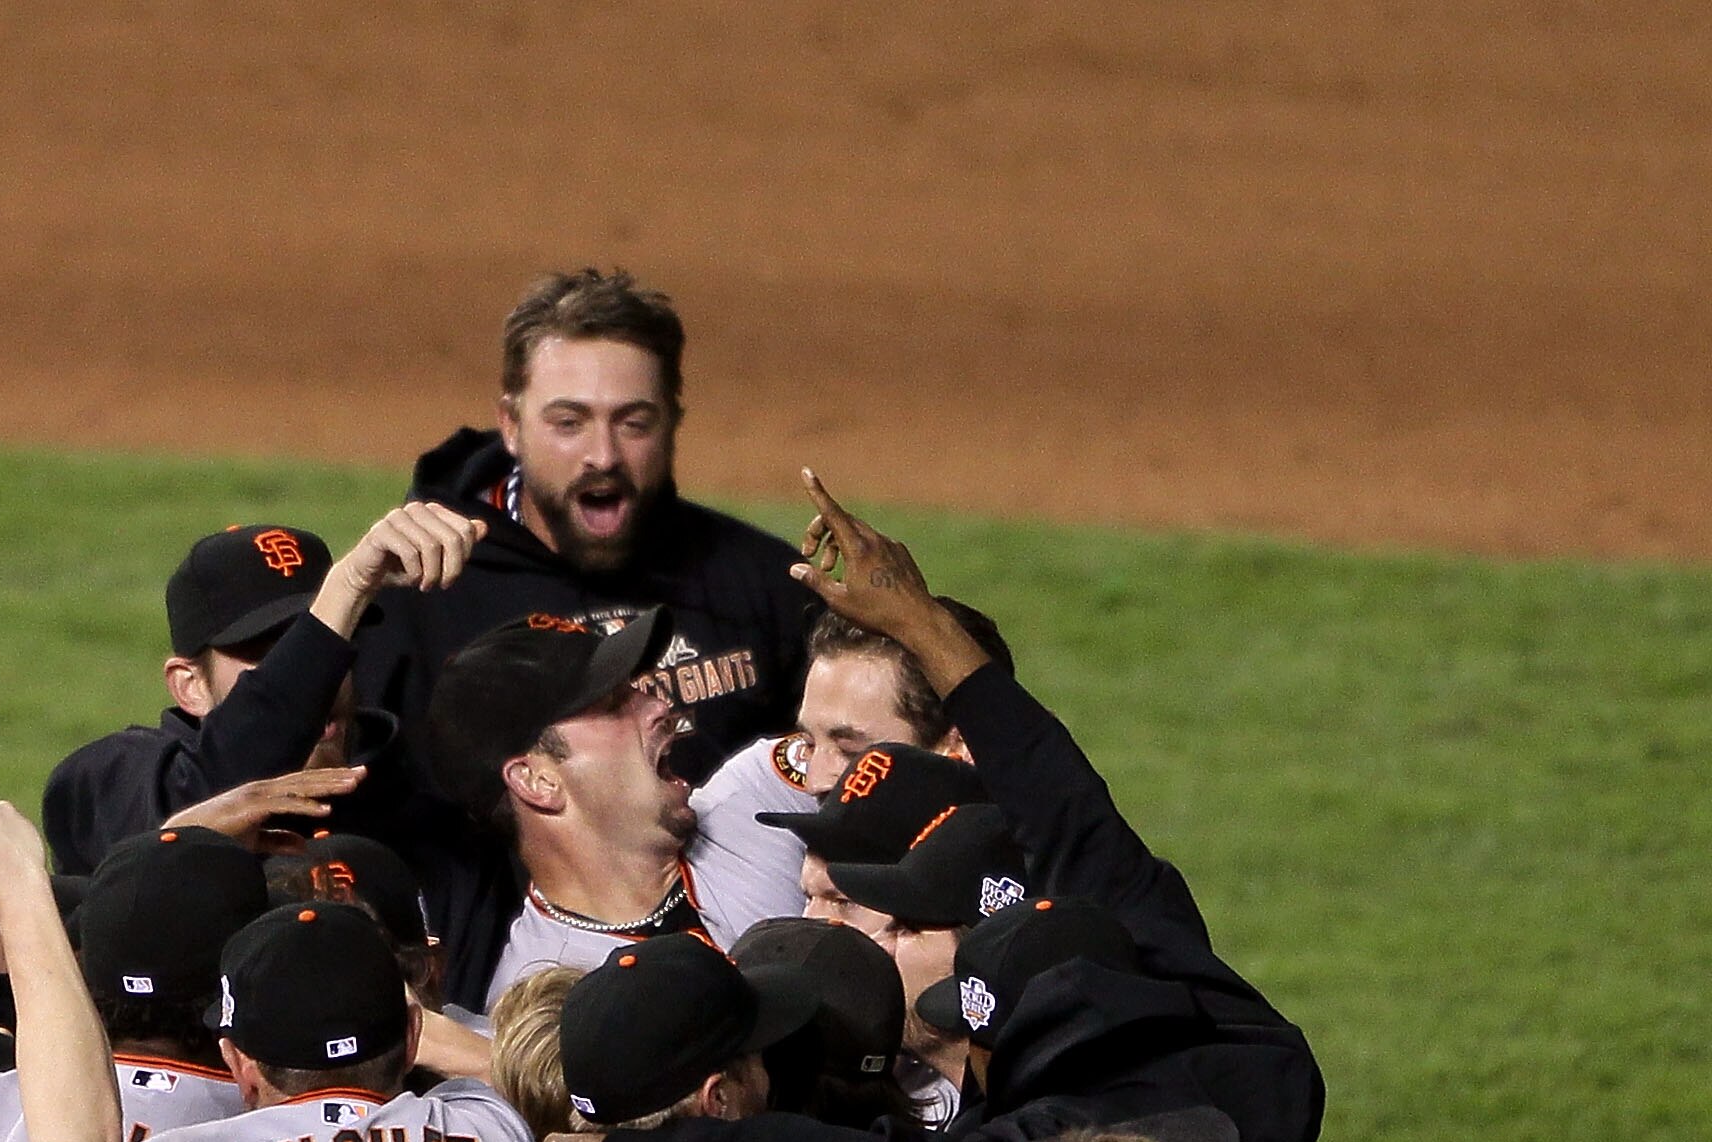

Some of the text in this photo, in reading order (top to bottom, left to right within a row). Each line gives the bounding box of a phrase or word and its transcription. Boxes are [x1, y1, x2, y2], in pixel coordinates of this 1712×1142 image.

[253, 529, 302, 577] SF
[675, 650, 757, 703] GIANTS
[840, 750, 892, 803] SF
[985, 881, 1018, 906] WOR
